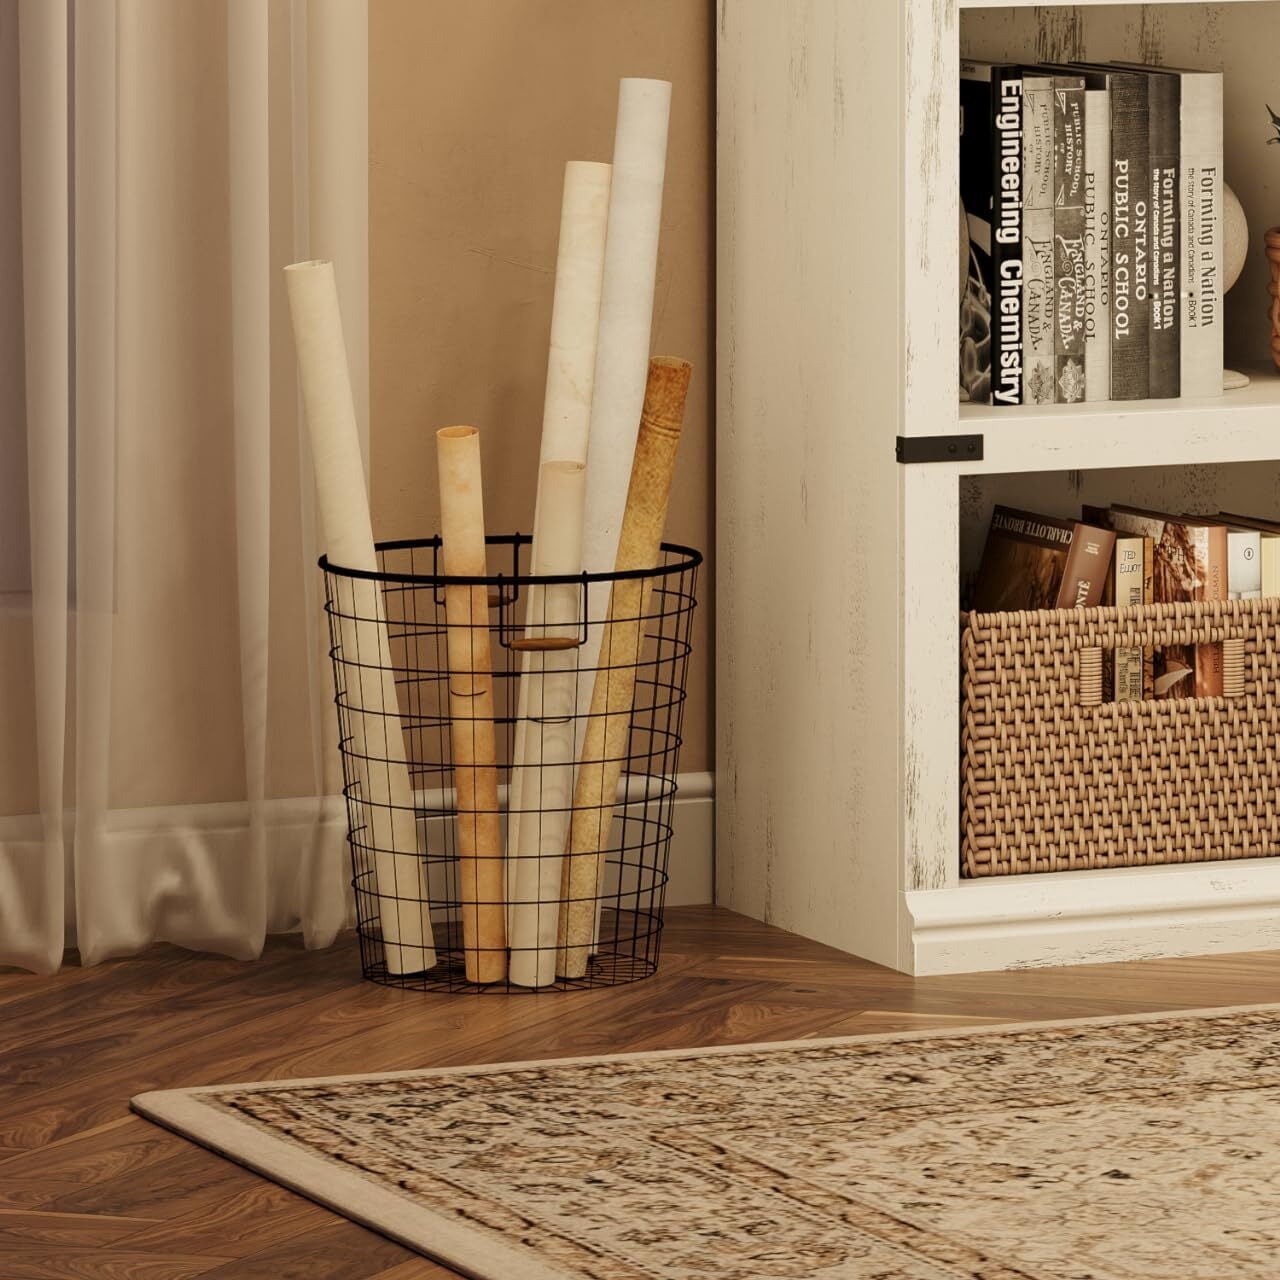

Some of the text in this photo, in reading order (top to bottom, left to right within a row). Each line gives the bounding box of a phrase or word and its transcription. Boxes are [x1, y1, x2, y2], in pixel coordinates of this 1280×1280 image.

[1033, 125, 1042, 175] HISTORY
[1039, 103, 1052, 198] PUBLIC SCHOOL
[1064, 124, 1073, 175] HISTORY
[1069, 102, 1083, 197] PUBLIC SCHOOL
[1188, 167, 1196, 179] the
[1153, 200, 1160, 209] of
[1188, 200, 1196, 208] of
[1188, 209, 1196, 234] Canada
[994, 79, 1023, 404] Engineering Chemistry
[1085, 172, 1096, 344] PUBLIC SCHOOL
[1100, 212, 1109, 306] ONTARIO
[1115, 159, 1129, 340] PUBLIC SCHOOL
[1135, 201, 1147, 301] ONTARIO
[1161, 167, 1176, 329] Forming a Nation
[1188, 235, 1196, 248] and
[1188, 249, 1196, 284] Canadians
[1198, 167, 1217, 327] Forming a Nation
[1025, 235, 1054, 318] ENGLAND
[1055, 234, 1085, 318] ENGLAND
[1153, 300, 1161, 324] Book
[1188, 300, 1197, 322] Book
[1025, 521, 1073, 545] CHARLOTTE
[1123, 550, 1136, 561] TED
[1212, 565, 1220, 600] OLMAN
